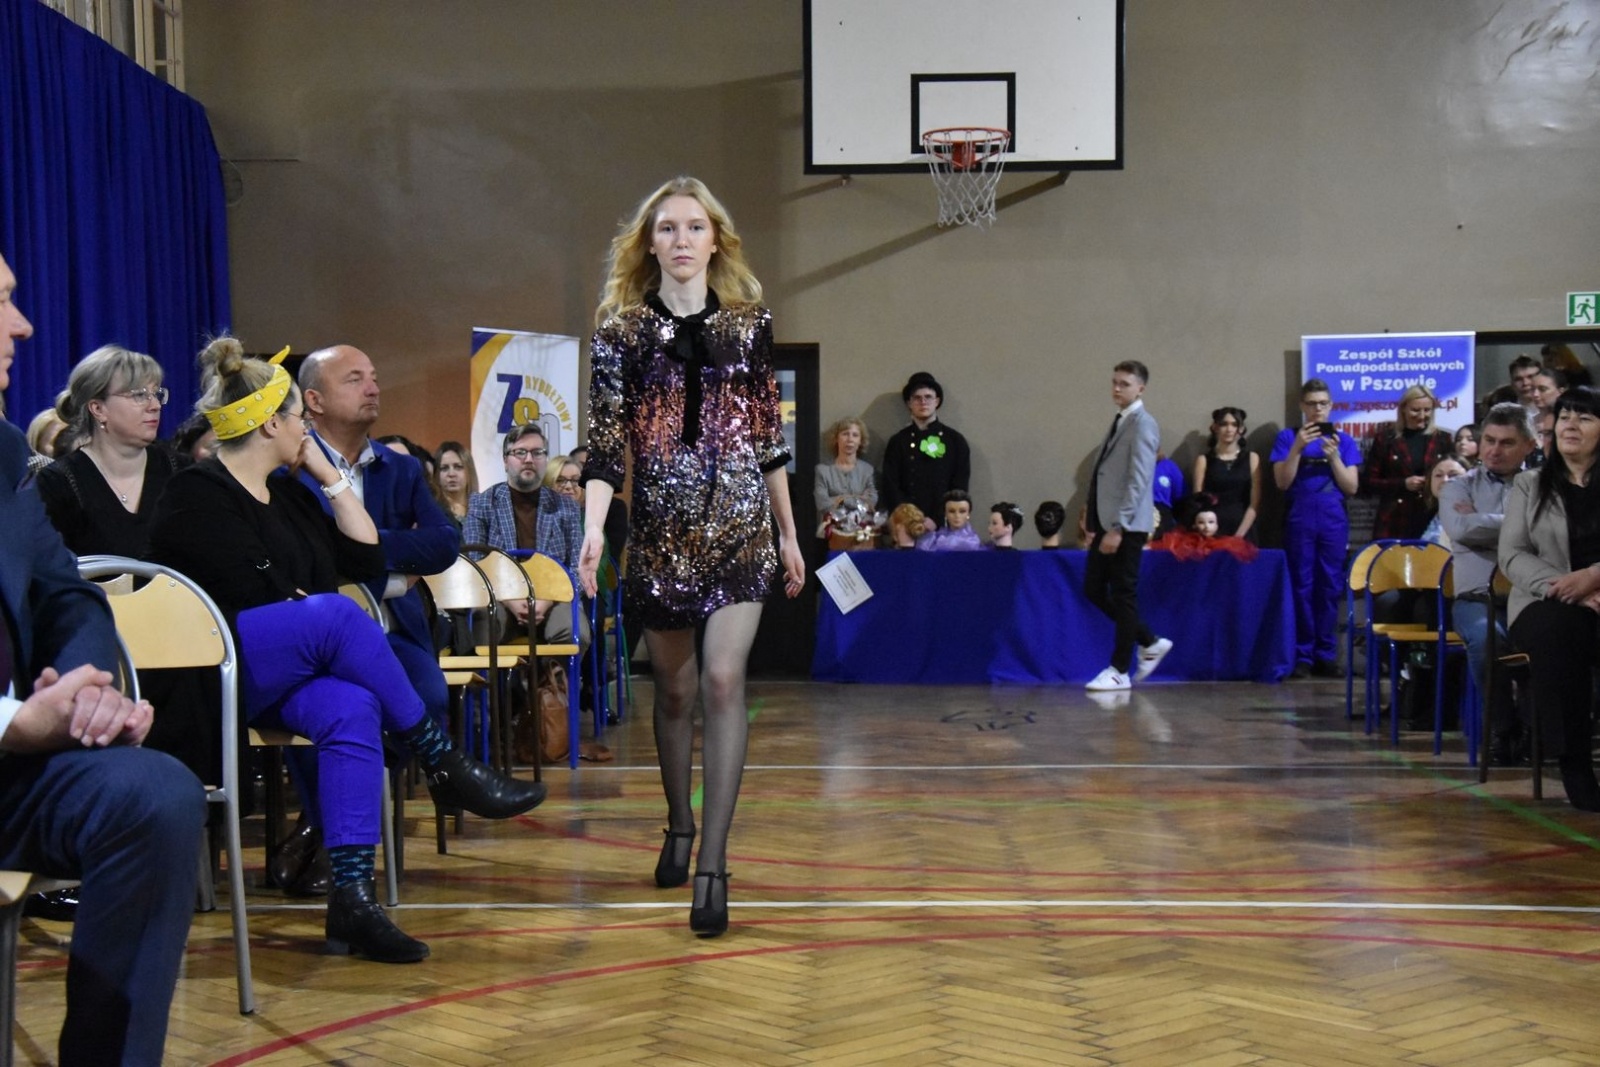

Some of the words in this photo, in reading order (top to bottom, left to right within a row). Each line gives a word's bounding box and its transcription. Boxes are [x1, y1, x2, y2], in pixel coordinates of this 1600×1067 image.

[1338, 349, 1393, 361] Zespół
[1397, 347, 1442, 359] Szkół
[1316, 360, 1465, 374] Ponadpodstawowych
[1341, 379, 1355, 391] w
